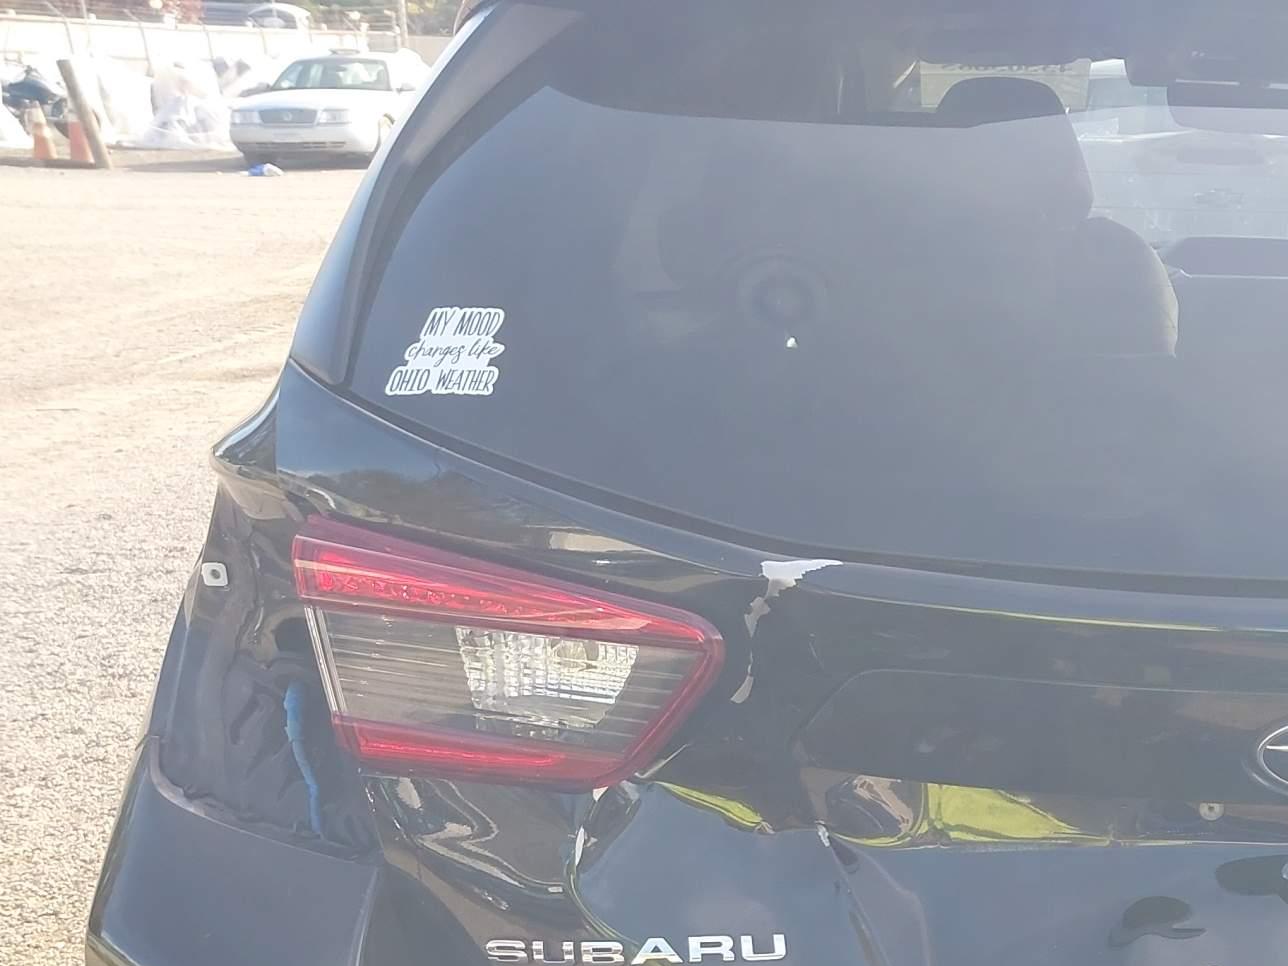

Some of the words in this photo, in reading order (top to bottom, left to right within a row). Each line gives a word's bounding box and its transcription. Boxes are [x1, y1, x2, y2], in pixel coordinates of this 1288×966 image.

[424, 310, 455, 337] MY
[453, 311, 501, 337] MOOD
[408, 339, 465, 368] changes
[467, 337, 501, 360] like
[389, 369, 431, 393] OHIO
[436, 369, 495, 393] WEATHER
[485, 934, 788, 966] SUBARU
